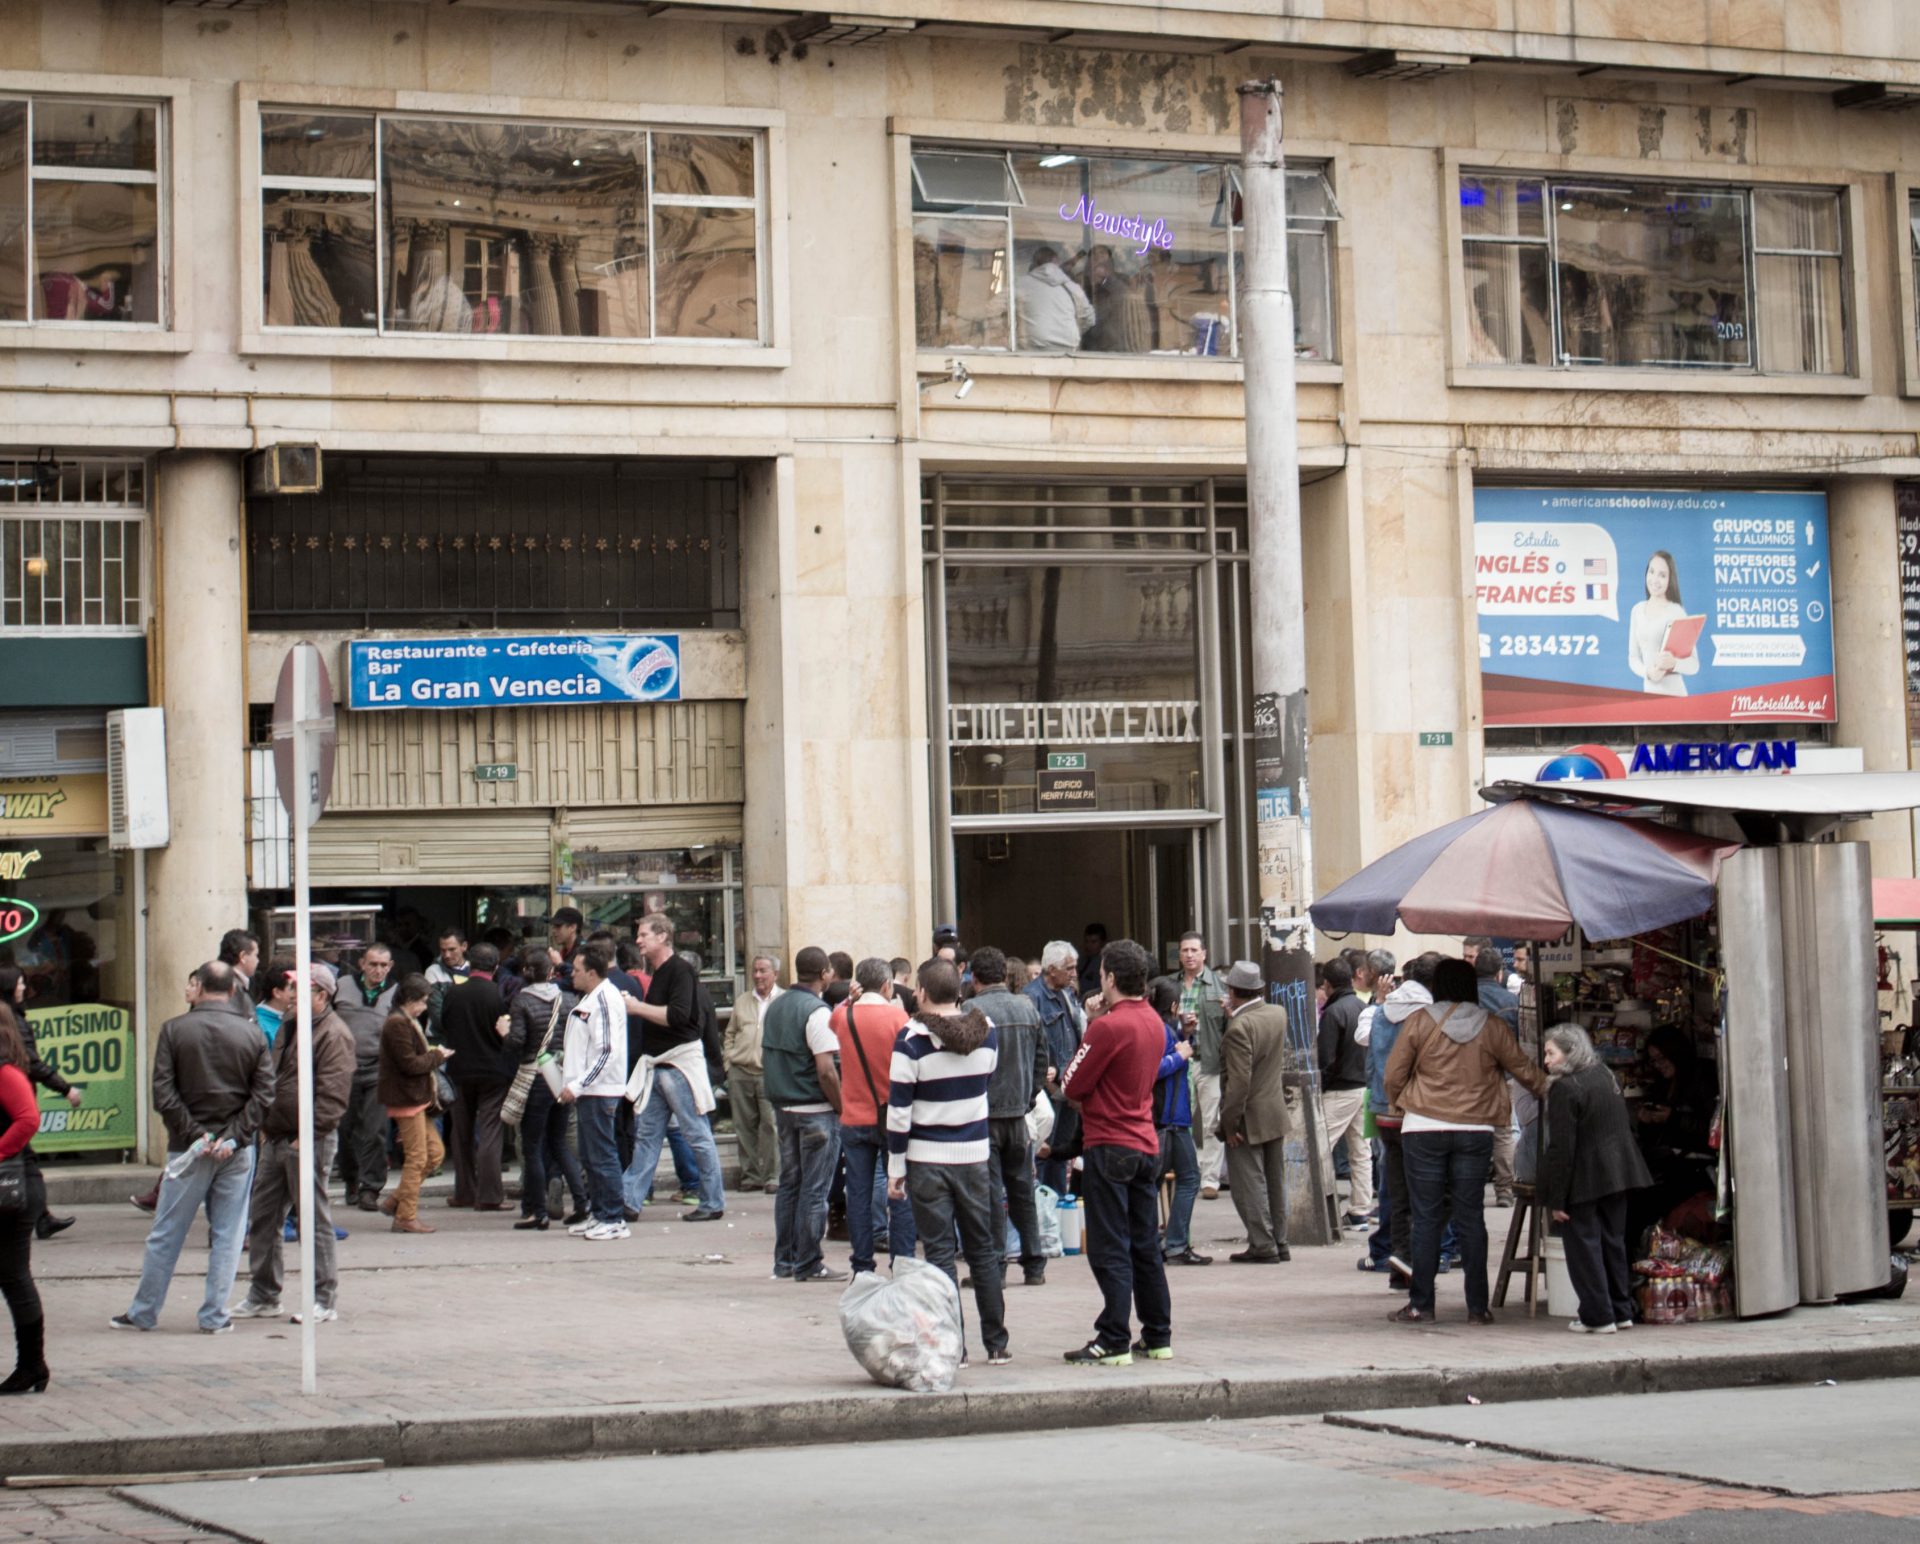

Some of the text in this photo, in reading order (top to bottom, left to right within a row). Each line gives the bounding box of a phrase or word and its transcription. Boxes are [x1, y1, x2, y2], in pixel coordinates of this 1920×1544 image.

[1058, 194, 1174, 254] Newstyle
[1551, 495, 1718, 510] americanschoolway.edu.co
[1713, 519, 1795, 533] GRUPOS DE
[1514, 531, 1560, 548] Estudia
[1713, 534, 1795, 545] 4 A 6 ALUMNOS
[1714, 554, 1797, 567] PROFESORES
[1715, 567, 1797, 585] NATIVOS
[1476, 581, 1576, 604] FRANCÉS
[1716, 598, 1799, 612] HORARIOS
[1717, 613, 1800, 628] FLEXIBLES
[368, 645, 487, 660] Restaurante
[506, 640, 593, 656] Cafetería
[1500, 635, 1600, 655] 2834372
[368, 662, 402, 675] Bar
[368, 673, 601, 701] La Gran Venecia
[1023, 702, 1114, 744] HENRY
[1123, 701, 1198, 743] FAUX
[1426, 734, 1445, 745] 7-31
[1056, 755, 1077, 766] 7-25
[1630, 739, 1797, 773] AMERICAN
[485, 766, 508, 777] 7-19
[1053, 780, 1083, 789] EDIFICIO
[1040, 791, 1064, 800] HENRY
[1065, 791, 1082, 800] FAUX
